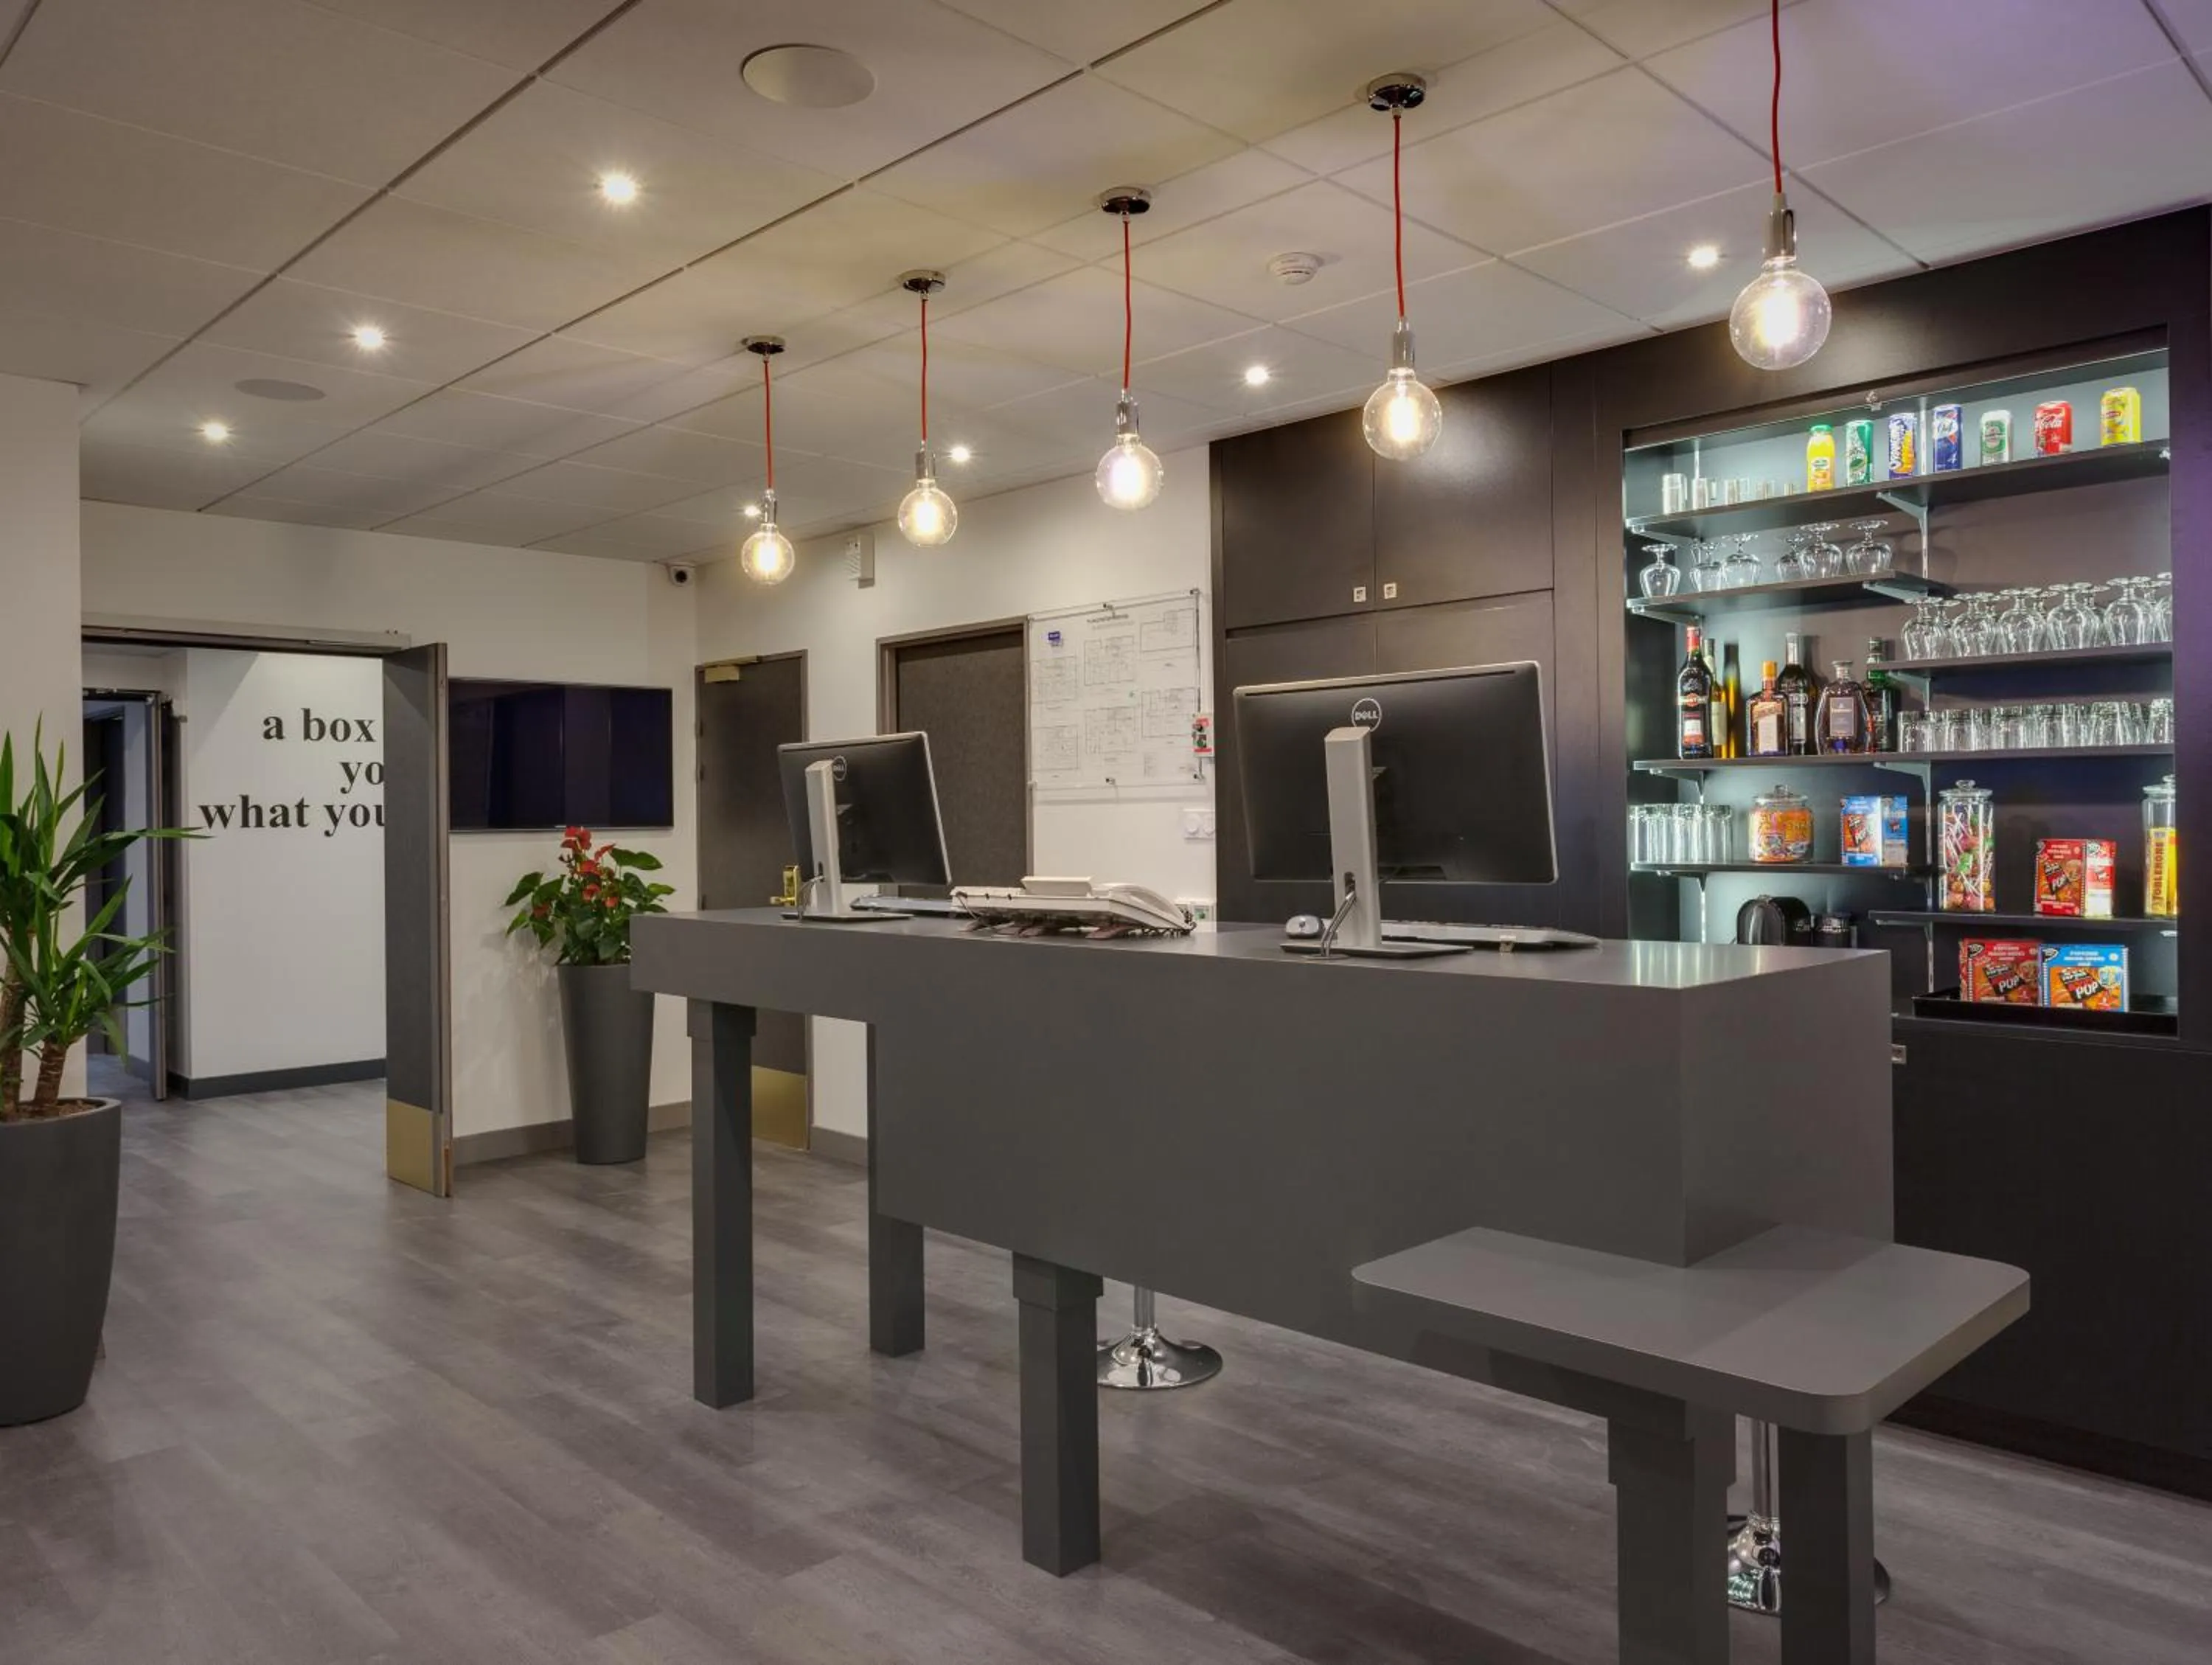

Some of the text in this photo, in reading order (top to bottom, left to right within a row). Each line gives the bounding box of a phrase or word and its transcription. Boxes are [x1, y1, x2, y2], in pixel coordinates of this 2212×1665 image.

[262, 707, 377, 743] a box
[1355, 711, 1378, 720] DELL
[198, 794, 310, 830] what
[2076, 981, 2098, 999] POP
